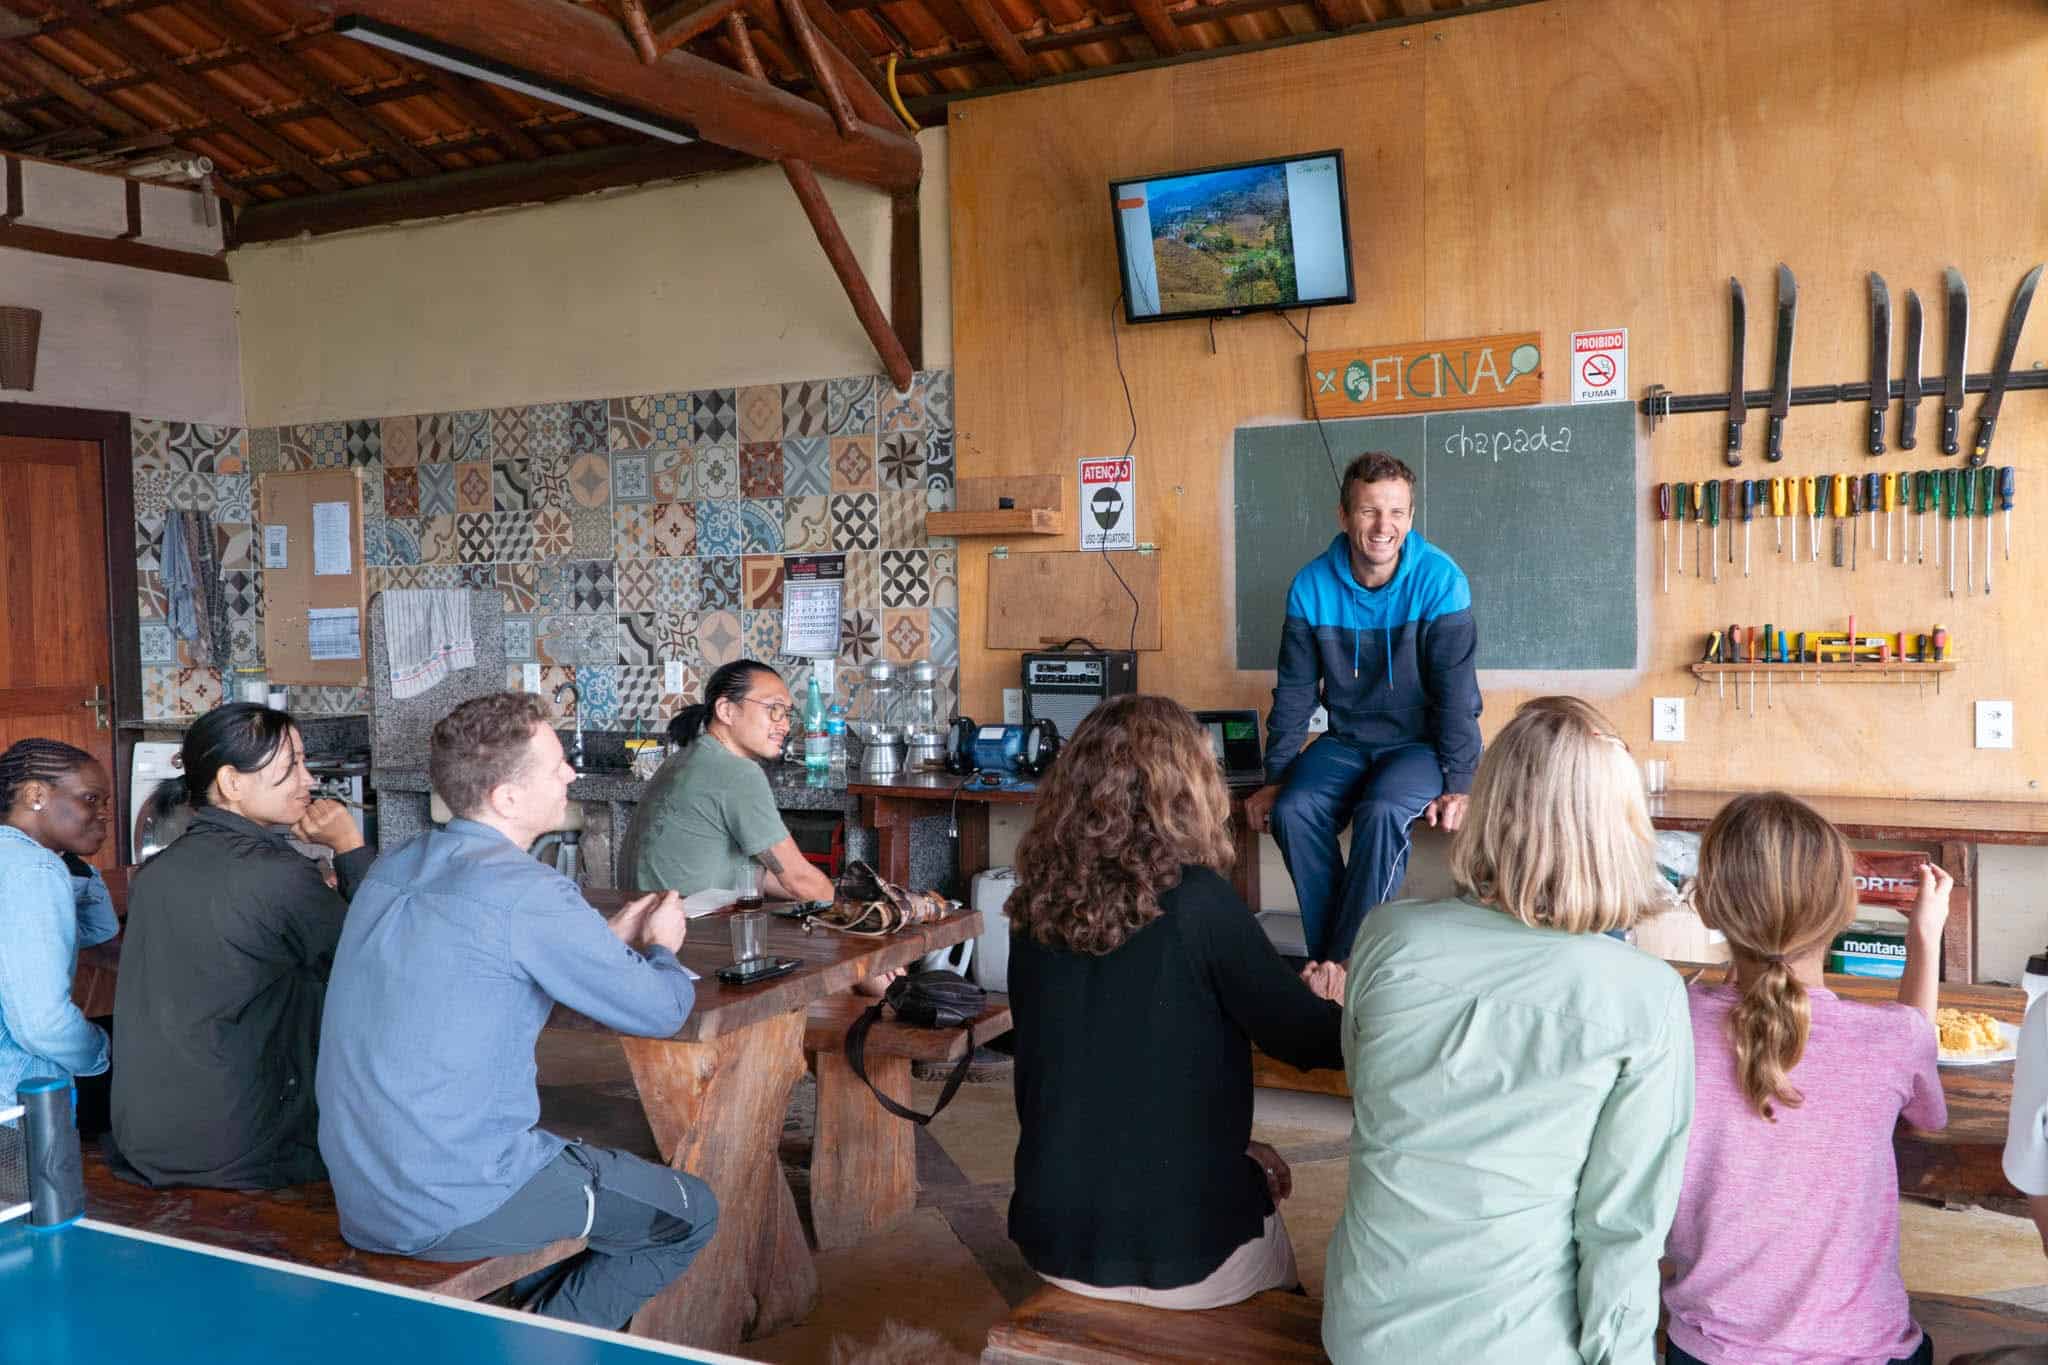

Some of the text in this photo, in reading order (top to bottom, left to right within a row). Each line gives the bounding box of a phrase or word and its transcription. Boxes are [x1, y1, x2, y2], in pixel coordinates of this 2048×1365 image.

[1576, 335, 1622, 350] PROIBIDO
[1582, 389, 1617, 399] FUMAR
[1445, 425, 1571, 463] chapada
[1844, 941, 1906, 955] montana
